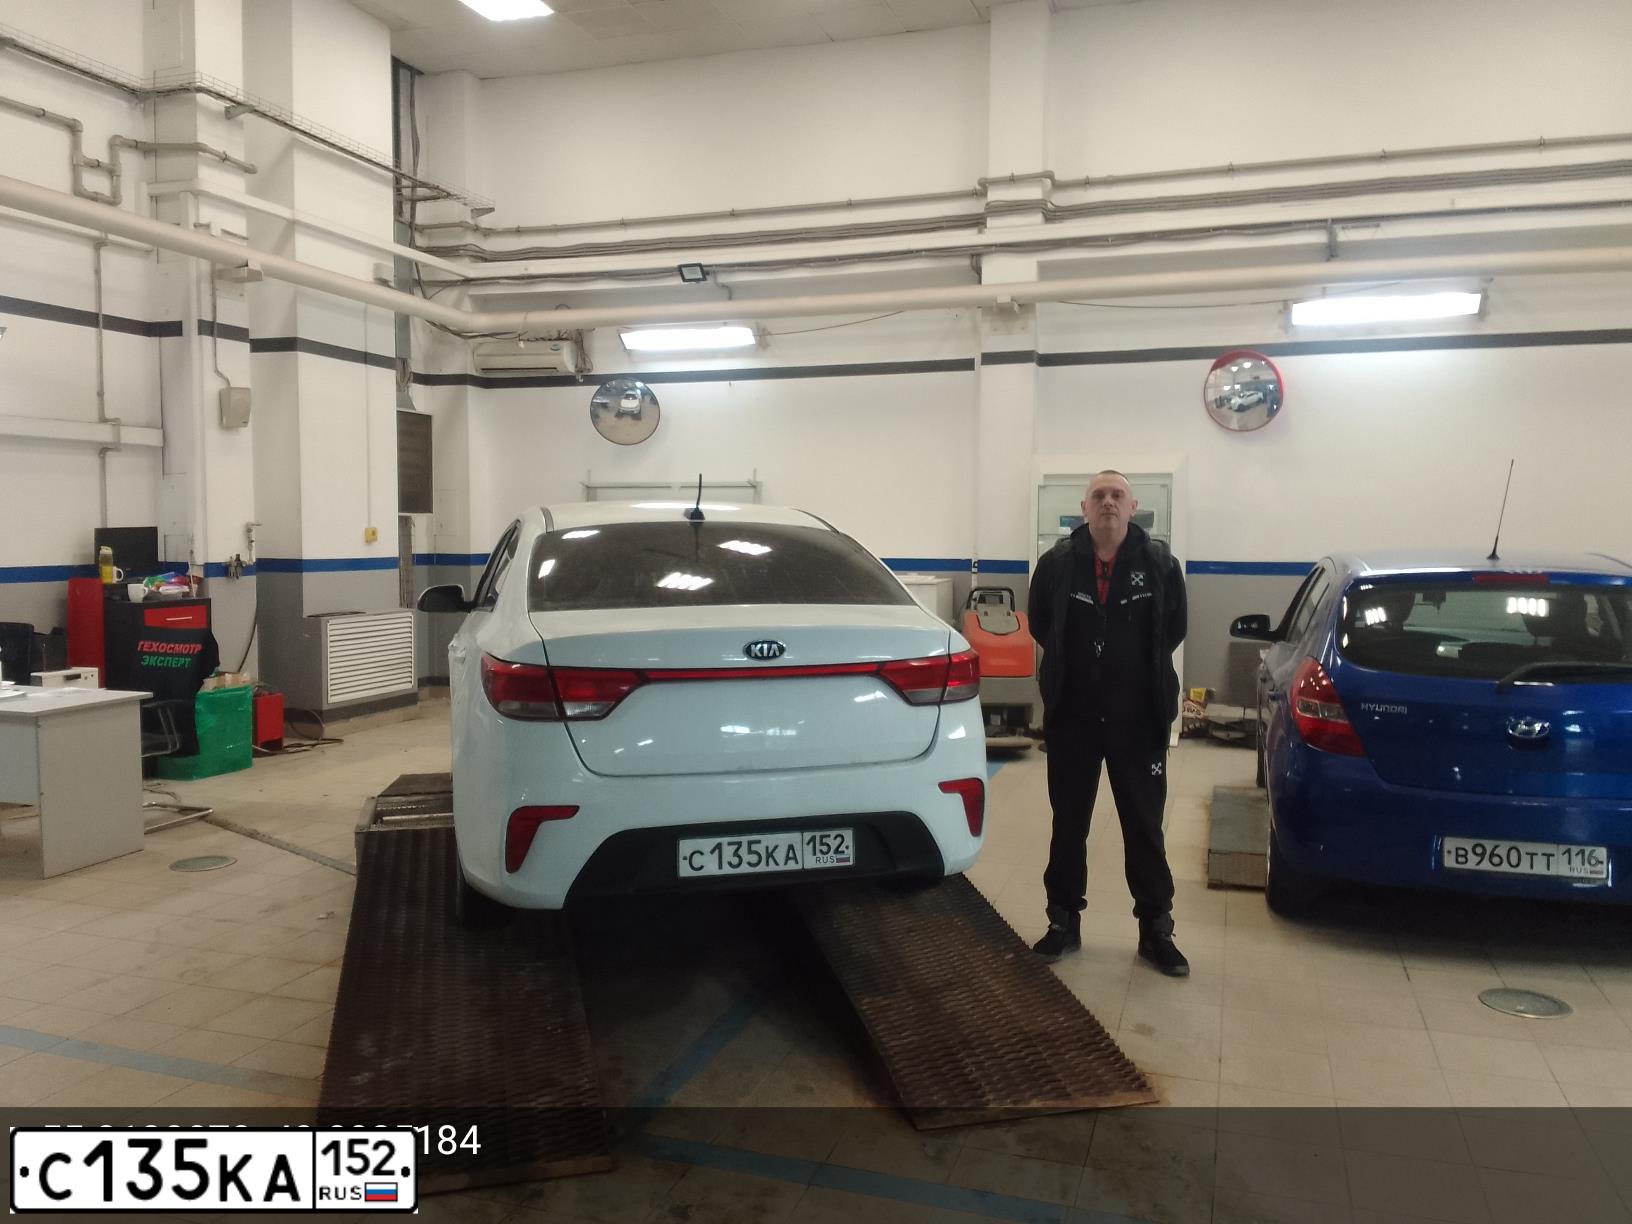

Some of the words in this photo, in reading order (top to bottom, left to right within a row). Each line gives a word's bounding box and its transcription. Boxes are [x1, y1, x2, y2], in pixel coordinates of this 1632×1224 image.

[750, 643, 780, 657] KIA
[141, 655, 191, 668] ЭКСПЕРТ
[1361, 702, 1408, 714] HYUNDAI
[688, 839, 799, 872] С135КА
[806, 833, 846, 857] 152
[1455, 843, 1555, 871] В960ТТ
[1562, 847, 1599, 867] 116
[815, 855, 835, 865] RUS
